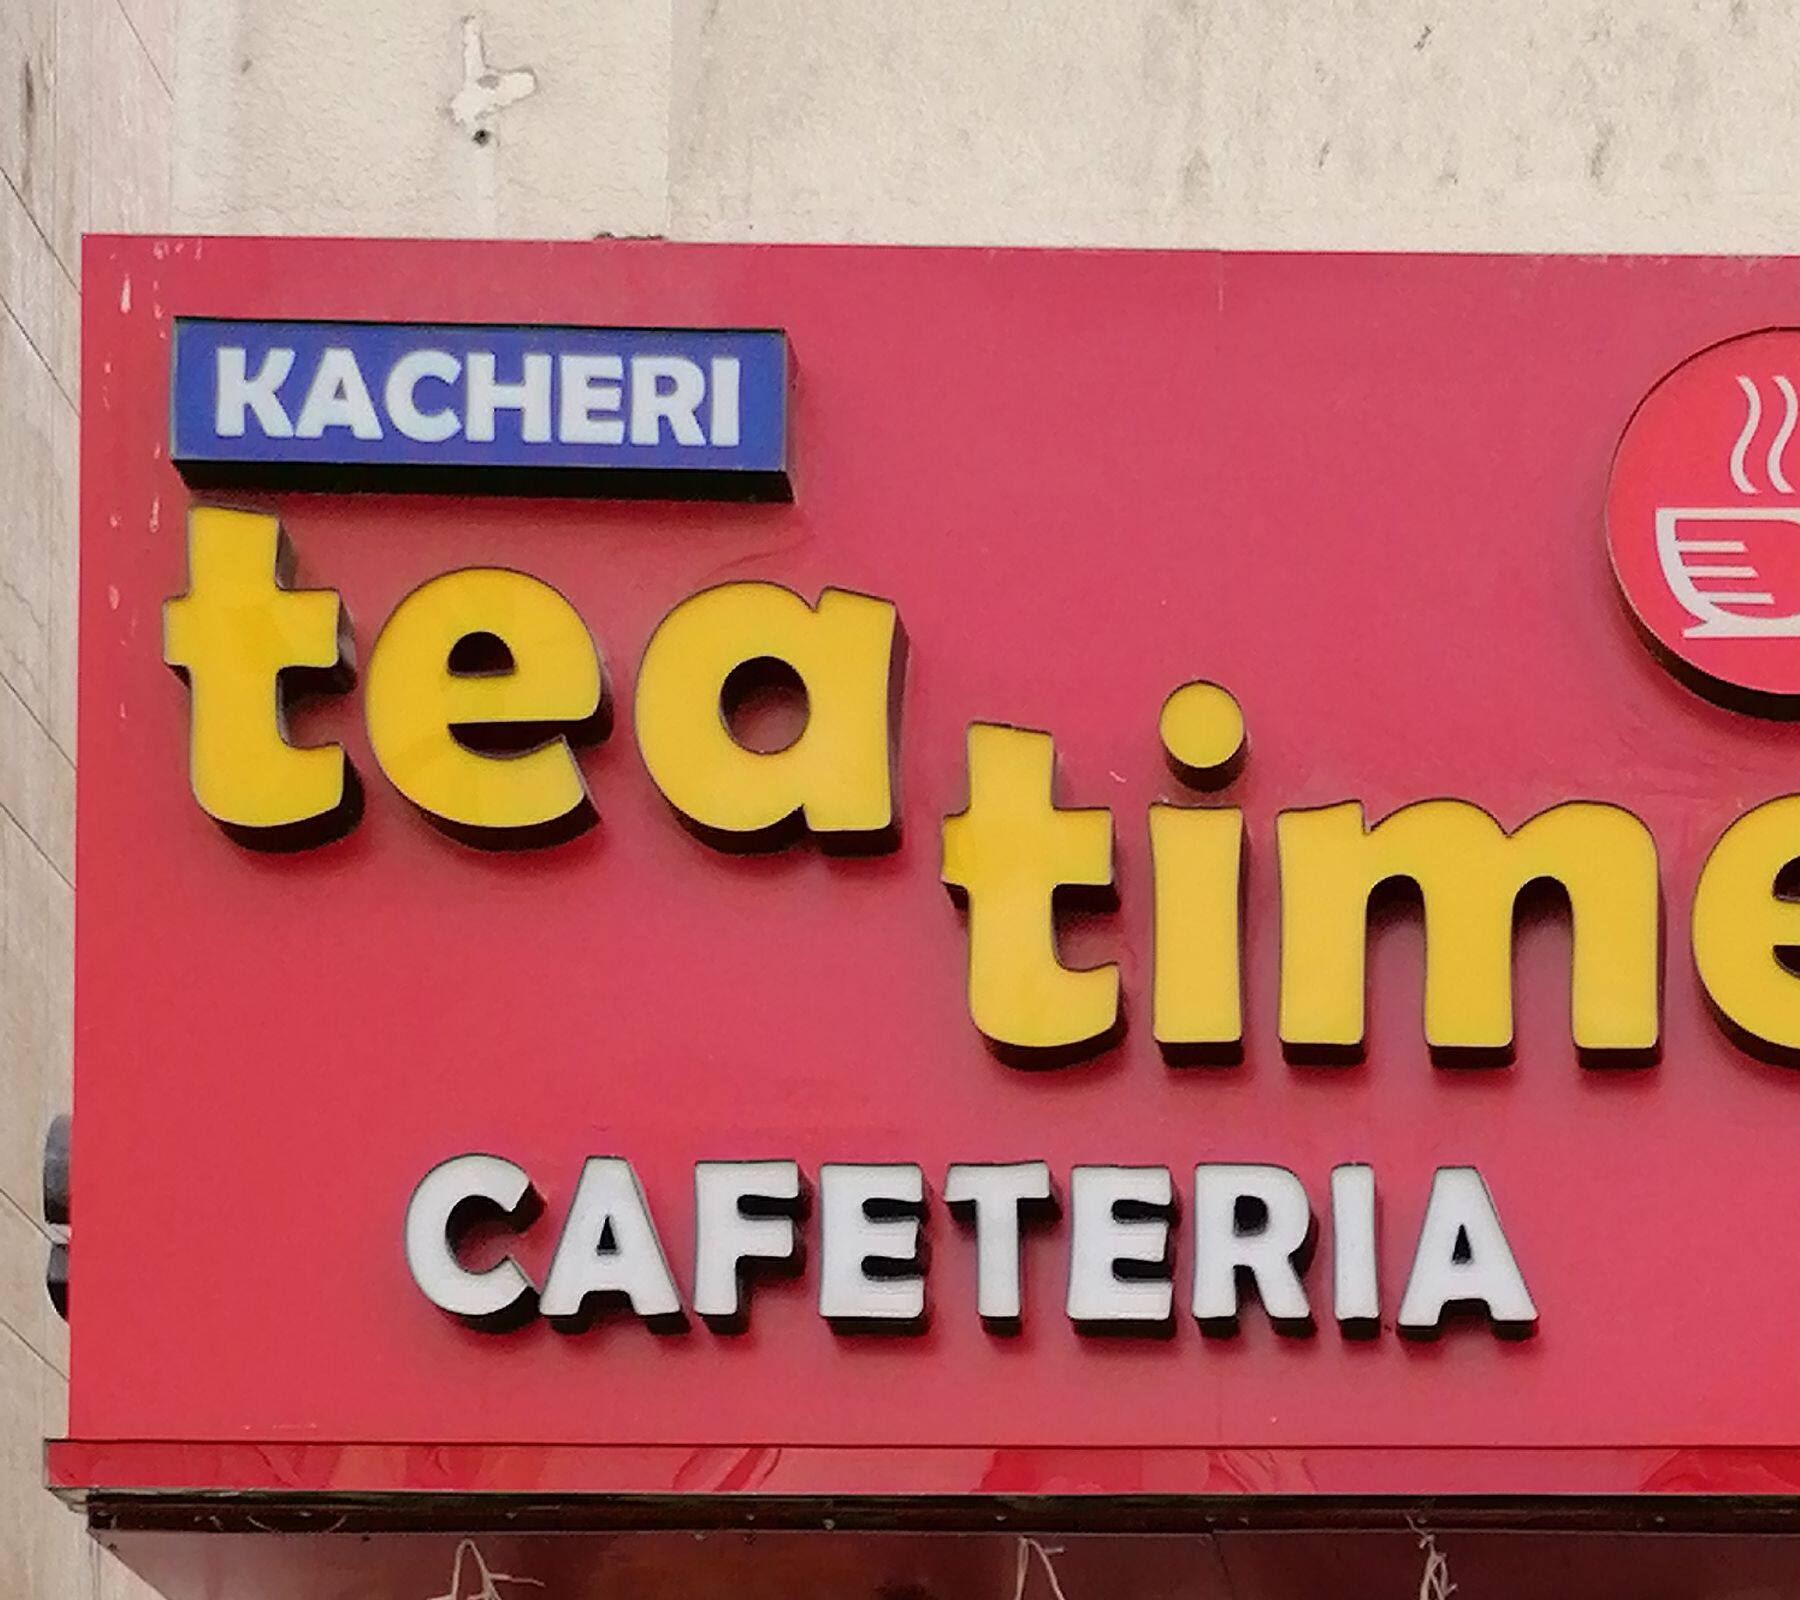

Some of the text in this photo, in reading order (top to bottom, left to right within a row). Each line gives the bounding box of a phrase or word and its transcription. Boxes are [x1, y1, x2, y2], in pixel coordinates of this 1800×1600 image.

[214, 346, 743, 449] KACHERI
[163, 507, 905, 845] tea
[405, 1153, 1538, 1330] CAFETERIA
